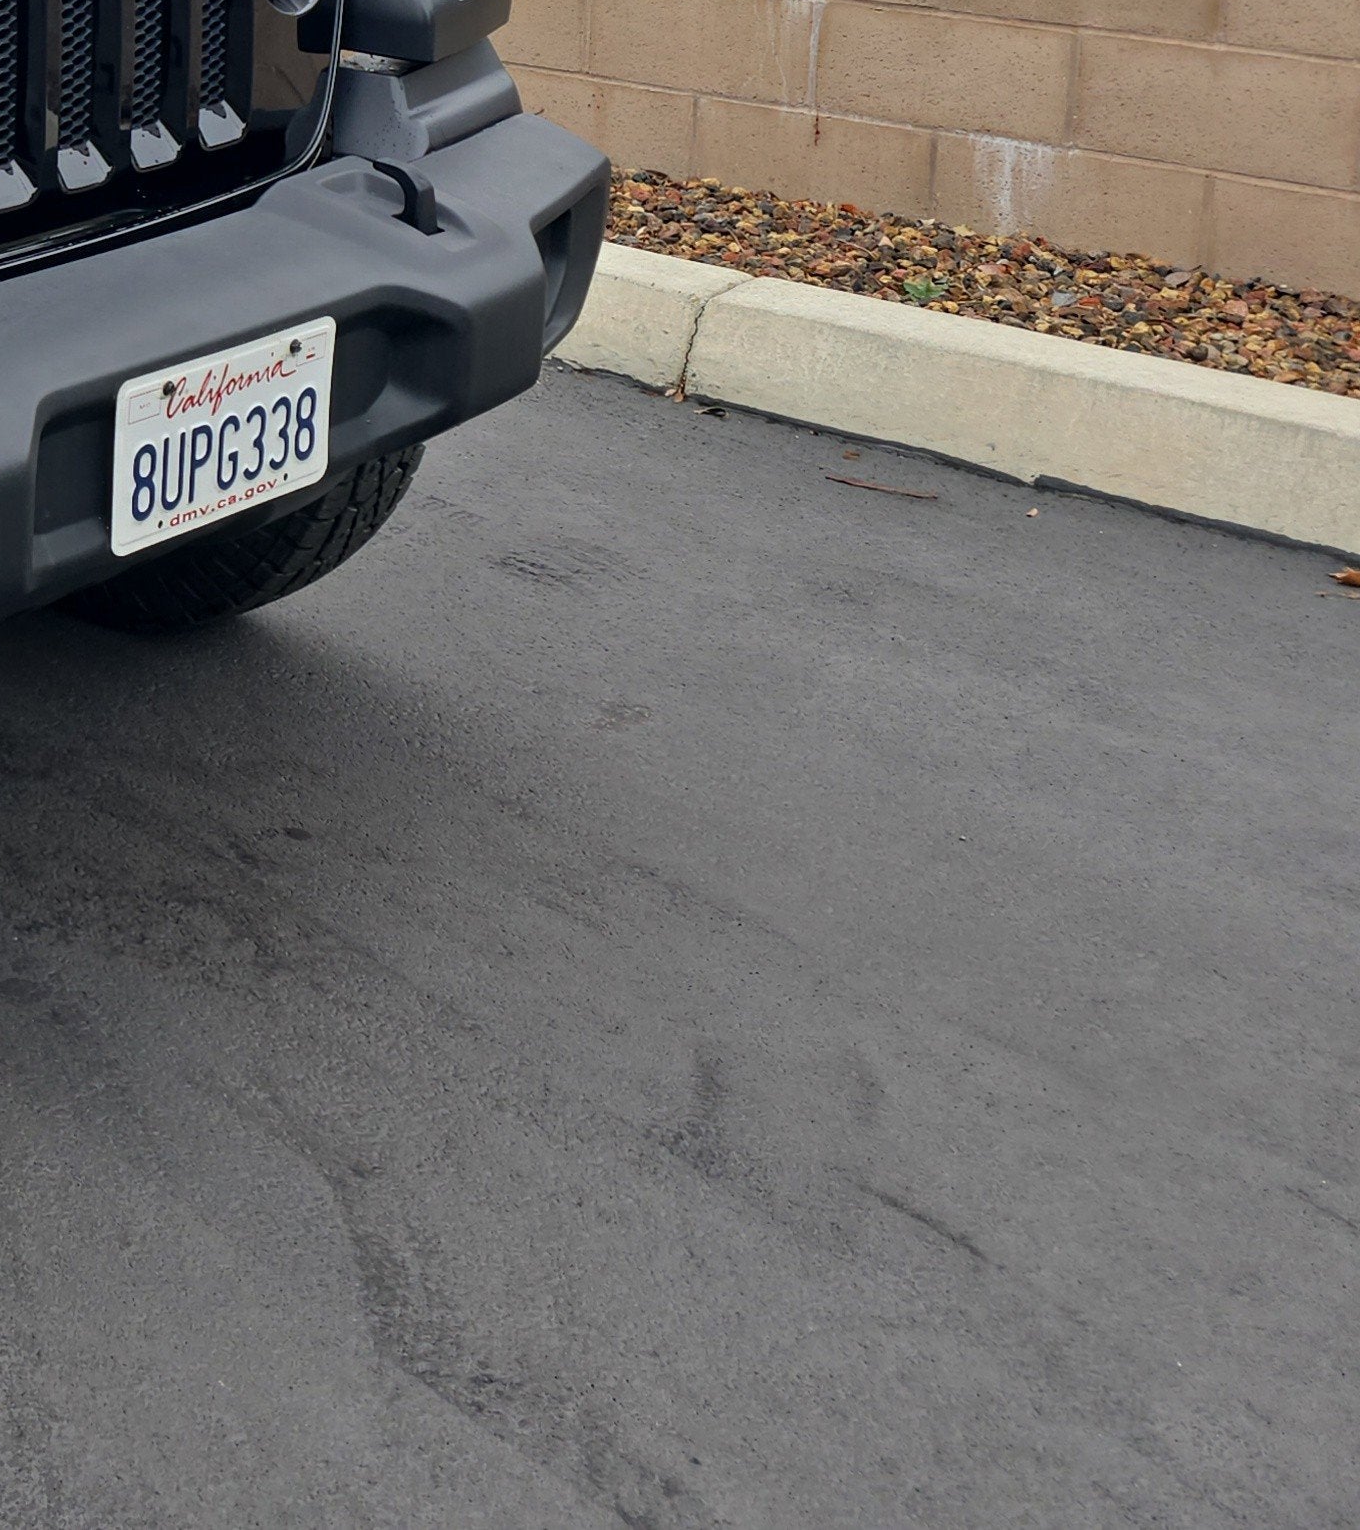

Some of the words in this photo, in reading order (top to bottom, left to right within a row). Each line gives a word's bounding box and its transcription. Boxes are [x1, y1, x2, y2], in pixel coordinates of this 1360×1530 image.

[166, 360, 297, 420] California
[131, 386, 318, 522] 8UPG338
[169, 478, 278, 528] dmv.ca.gov
